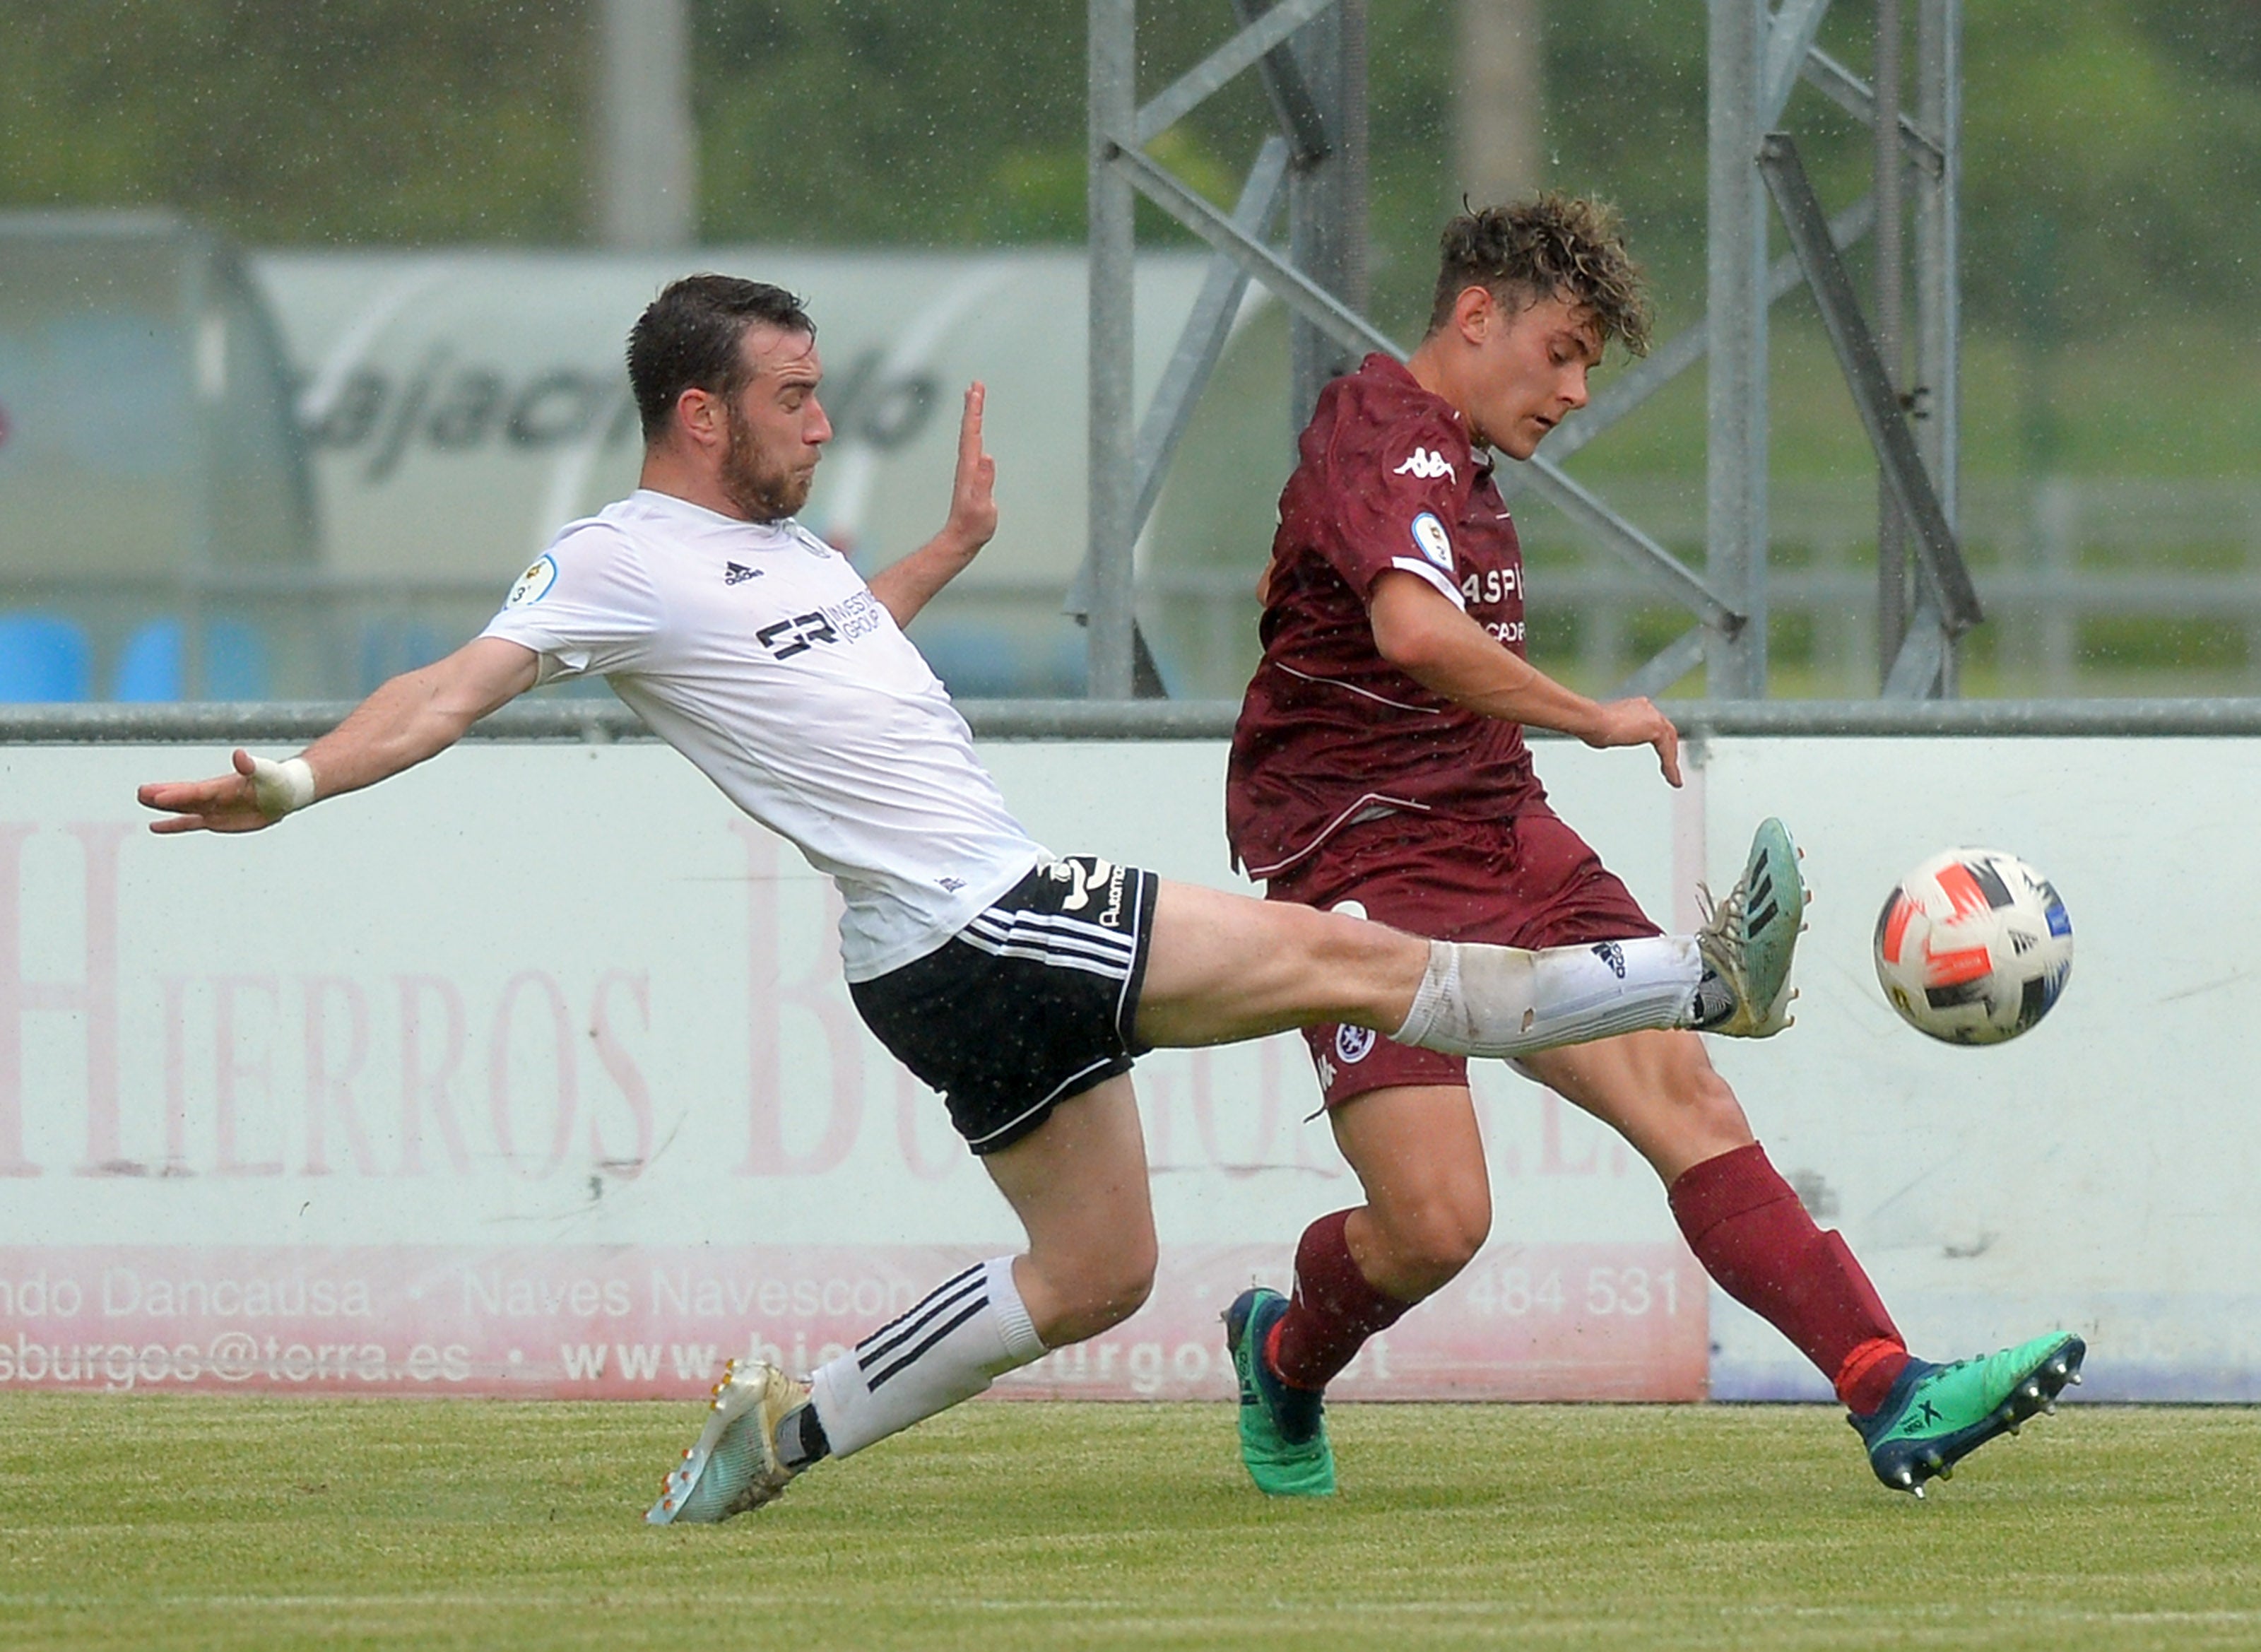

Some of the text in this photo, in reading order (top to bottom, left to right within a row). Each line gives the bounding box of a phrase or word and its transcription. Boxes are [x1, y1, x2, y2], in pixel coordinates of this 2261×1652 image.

[842, 608, 880, 639] GROUP
[103, 1268, 371, 1317] Dancausa
[464, 1270, 631, 1317] Naves
[1466, 1267, 1566, 1316] 484
[1586, 1268, 1677, 1316] 531
